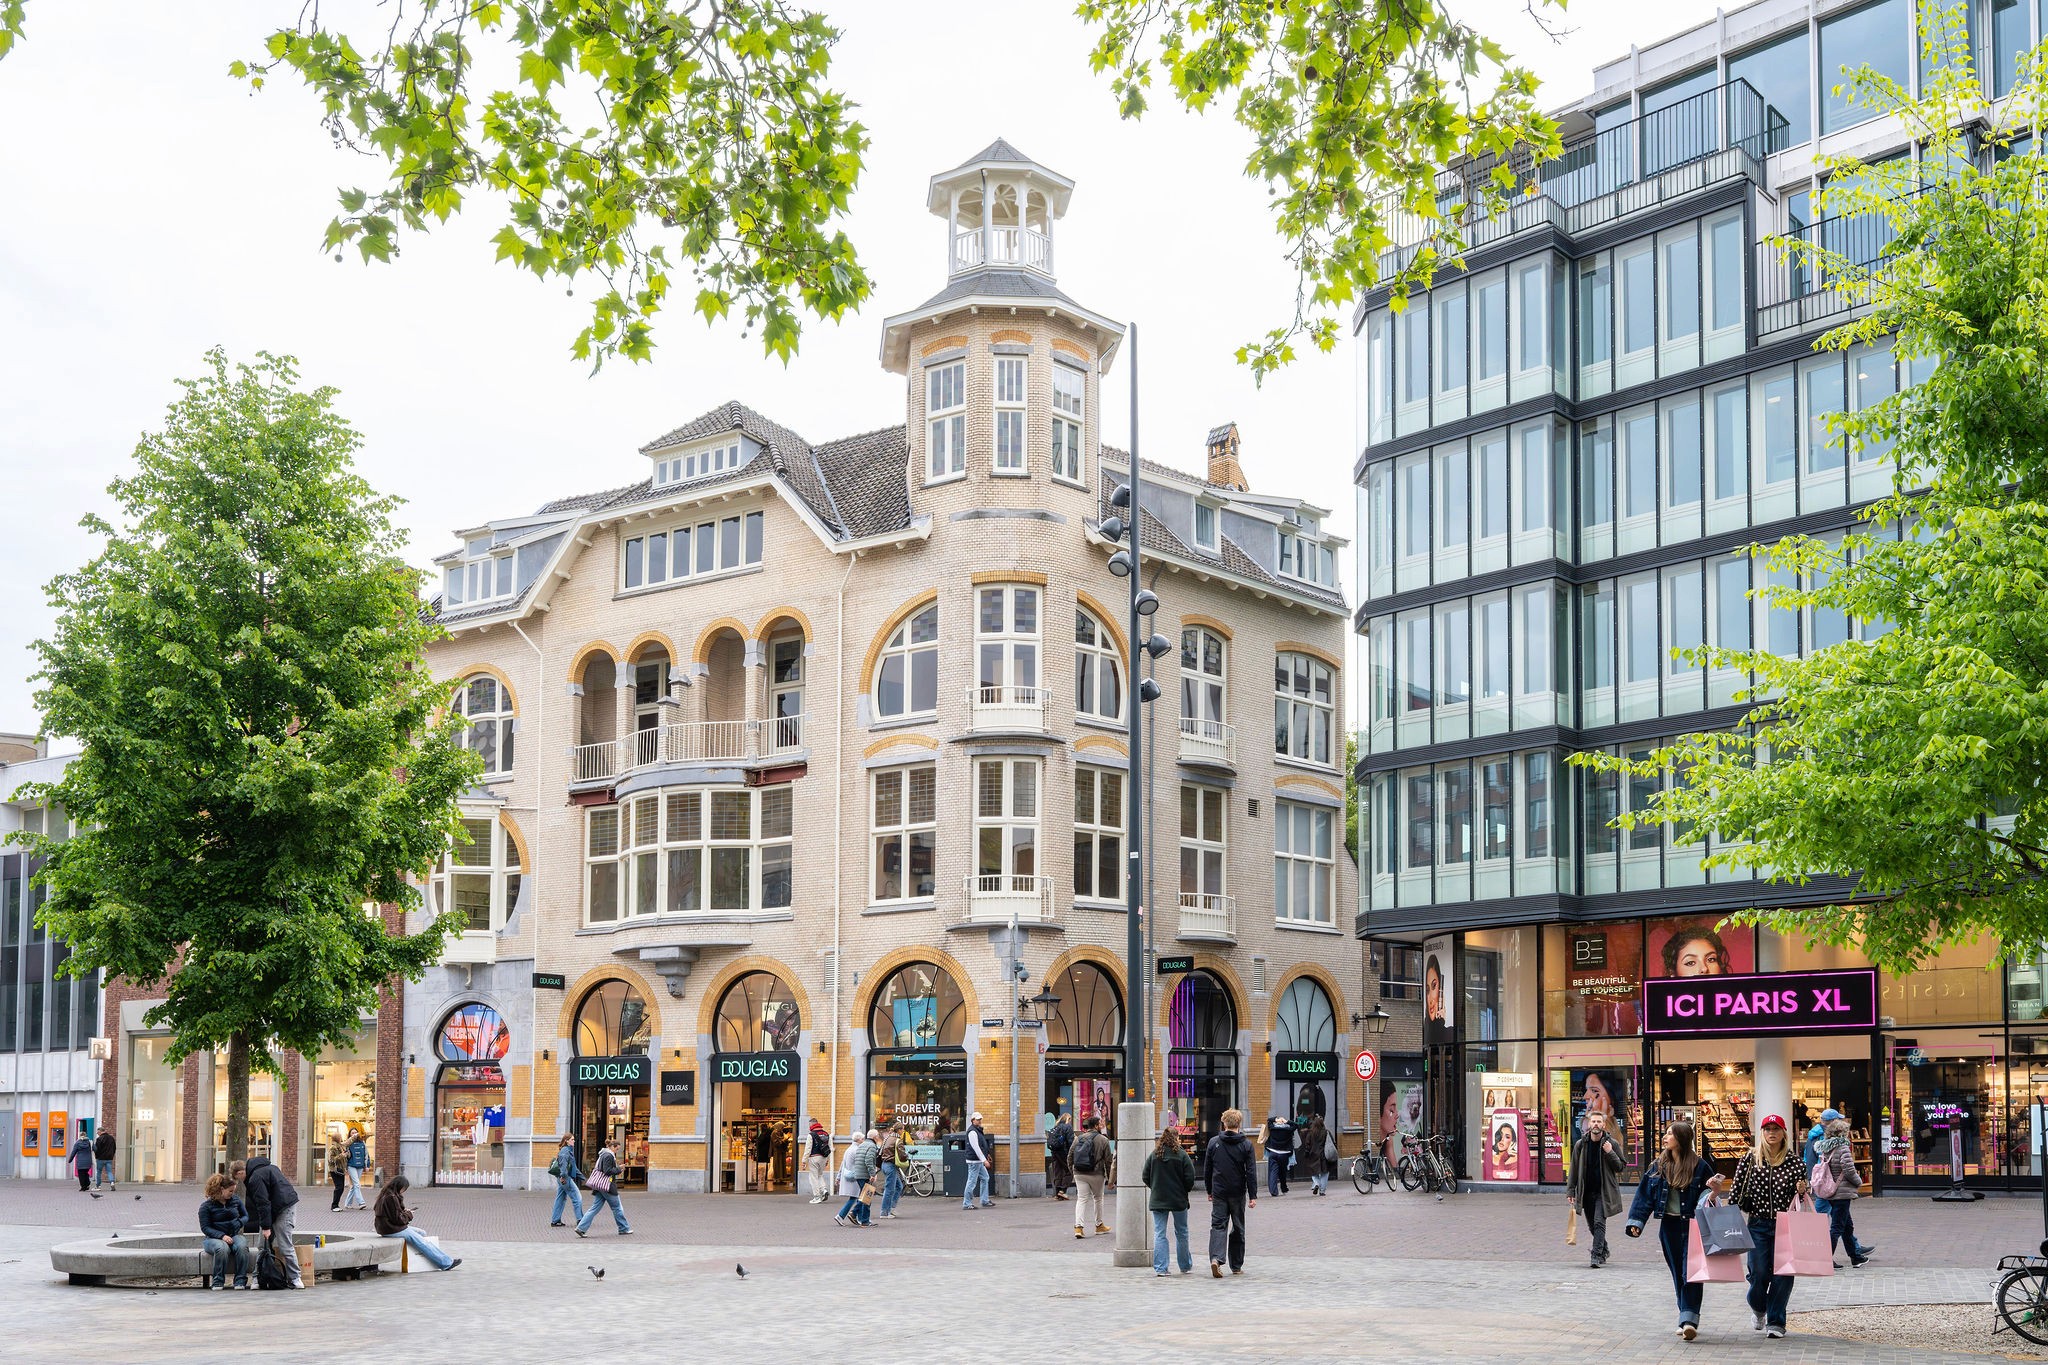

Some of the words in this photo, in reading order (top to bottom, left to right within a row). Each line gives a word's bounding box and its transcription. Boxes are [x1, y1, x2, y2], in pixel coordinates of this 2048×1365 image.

[1576, 939, 1603, 960] BE
[1162, 960, 1187, 969] DOUGLAS
[540, 977, 560, 985] DOUGLAS
[1572, 979, 1583, 987] BE
[1584, 976, 1628, 986] BEAUTIFUL
[1580, 987, 1591, 995] BE
[1592, 985, 1633, 994] YOURSELF
[1666, 994, 1704, 1017] ICI
[1715, 990, 1799, 1016] PARIS
[1811, 988, 1850, 1012] XL
[579, 1063, 640, 1080] DOUGLAS
[721, 1059, 788, 1078] DOUGLAS
[1288, 1060, 1326, 1073] DOUGLAS
[666, 1084, 688, 1092] DOUGLAS
[895, 1103, 941, 1113] FOREVER
[1923, 1103, 1936, 1111] we
[1938, 1102, 1957, 1110] love
[896, 1115, 940, 1125] SUMMER
[1927, 1112, 1944, 1120] you
